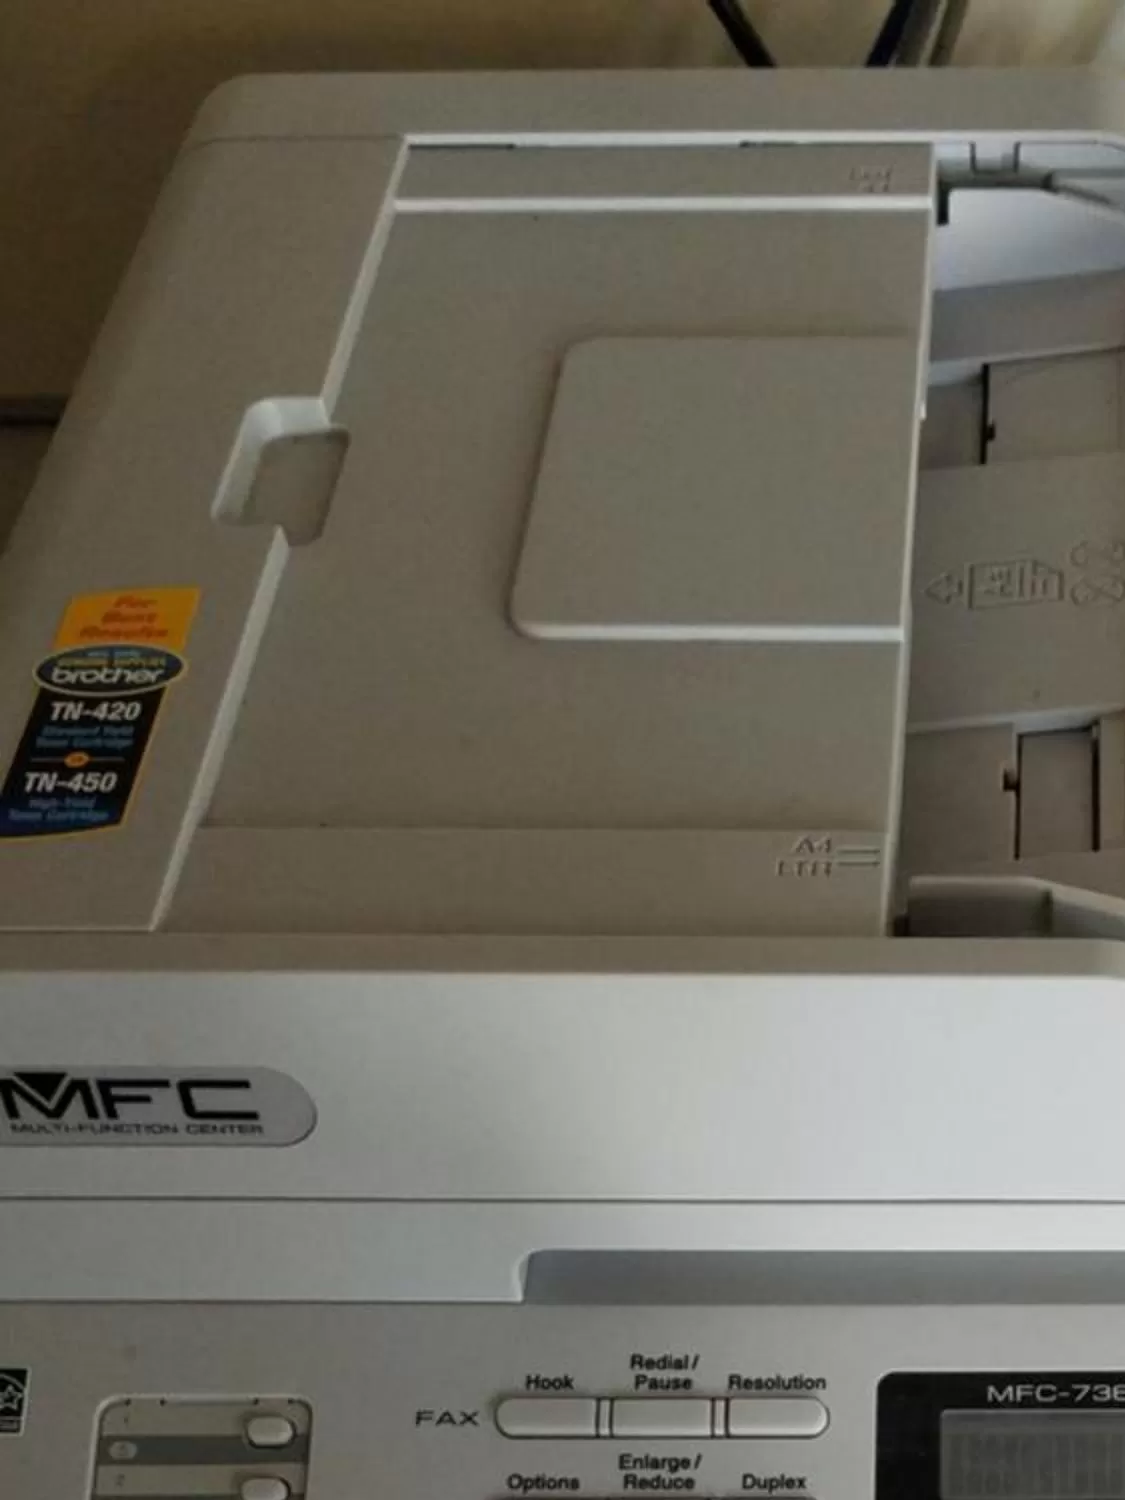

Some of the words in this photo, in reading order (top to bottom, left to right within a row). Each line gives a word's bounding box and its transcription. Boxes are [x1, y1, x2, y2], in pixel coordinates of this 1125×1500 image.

[51, 666, 164, 684] brother
[50, 702, 142, 721] TN-420
[24, 772, 118, 793] TN-450
[0, 1075, 260, 1121] MFC
[10, 1123, 180, 1136] MULTI-FUNCTION
[185, 1123, 265, 1136] CENTER
[525, 1374, 574, 1391] Hook
[634, 1375, 693, 1391] Pause
[728, 1374, 827, 1391] Resolution
[415, 1411, 480, 1427] FAX
[507, 1474, 580, 1493] Options
[623, 1474, 696, 1491] Reduce
[742, 1474, 807, 1493] Duplex
